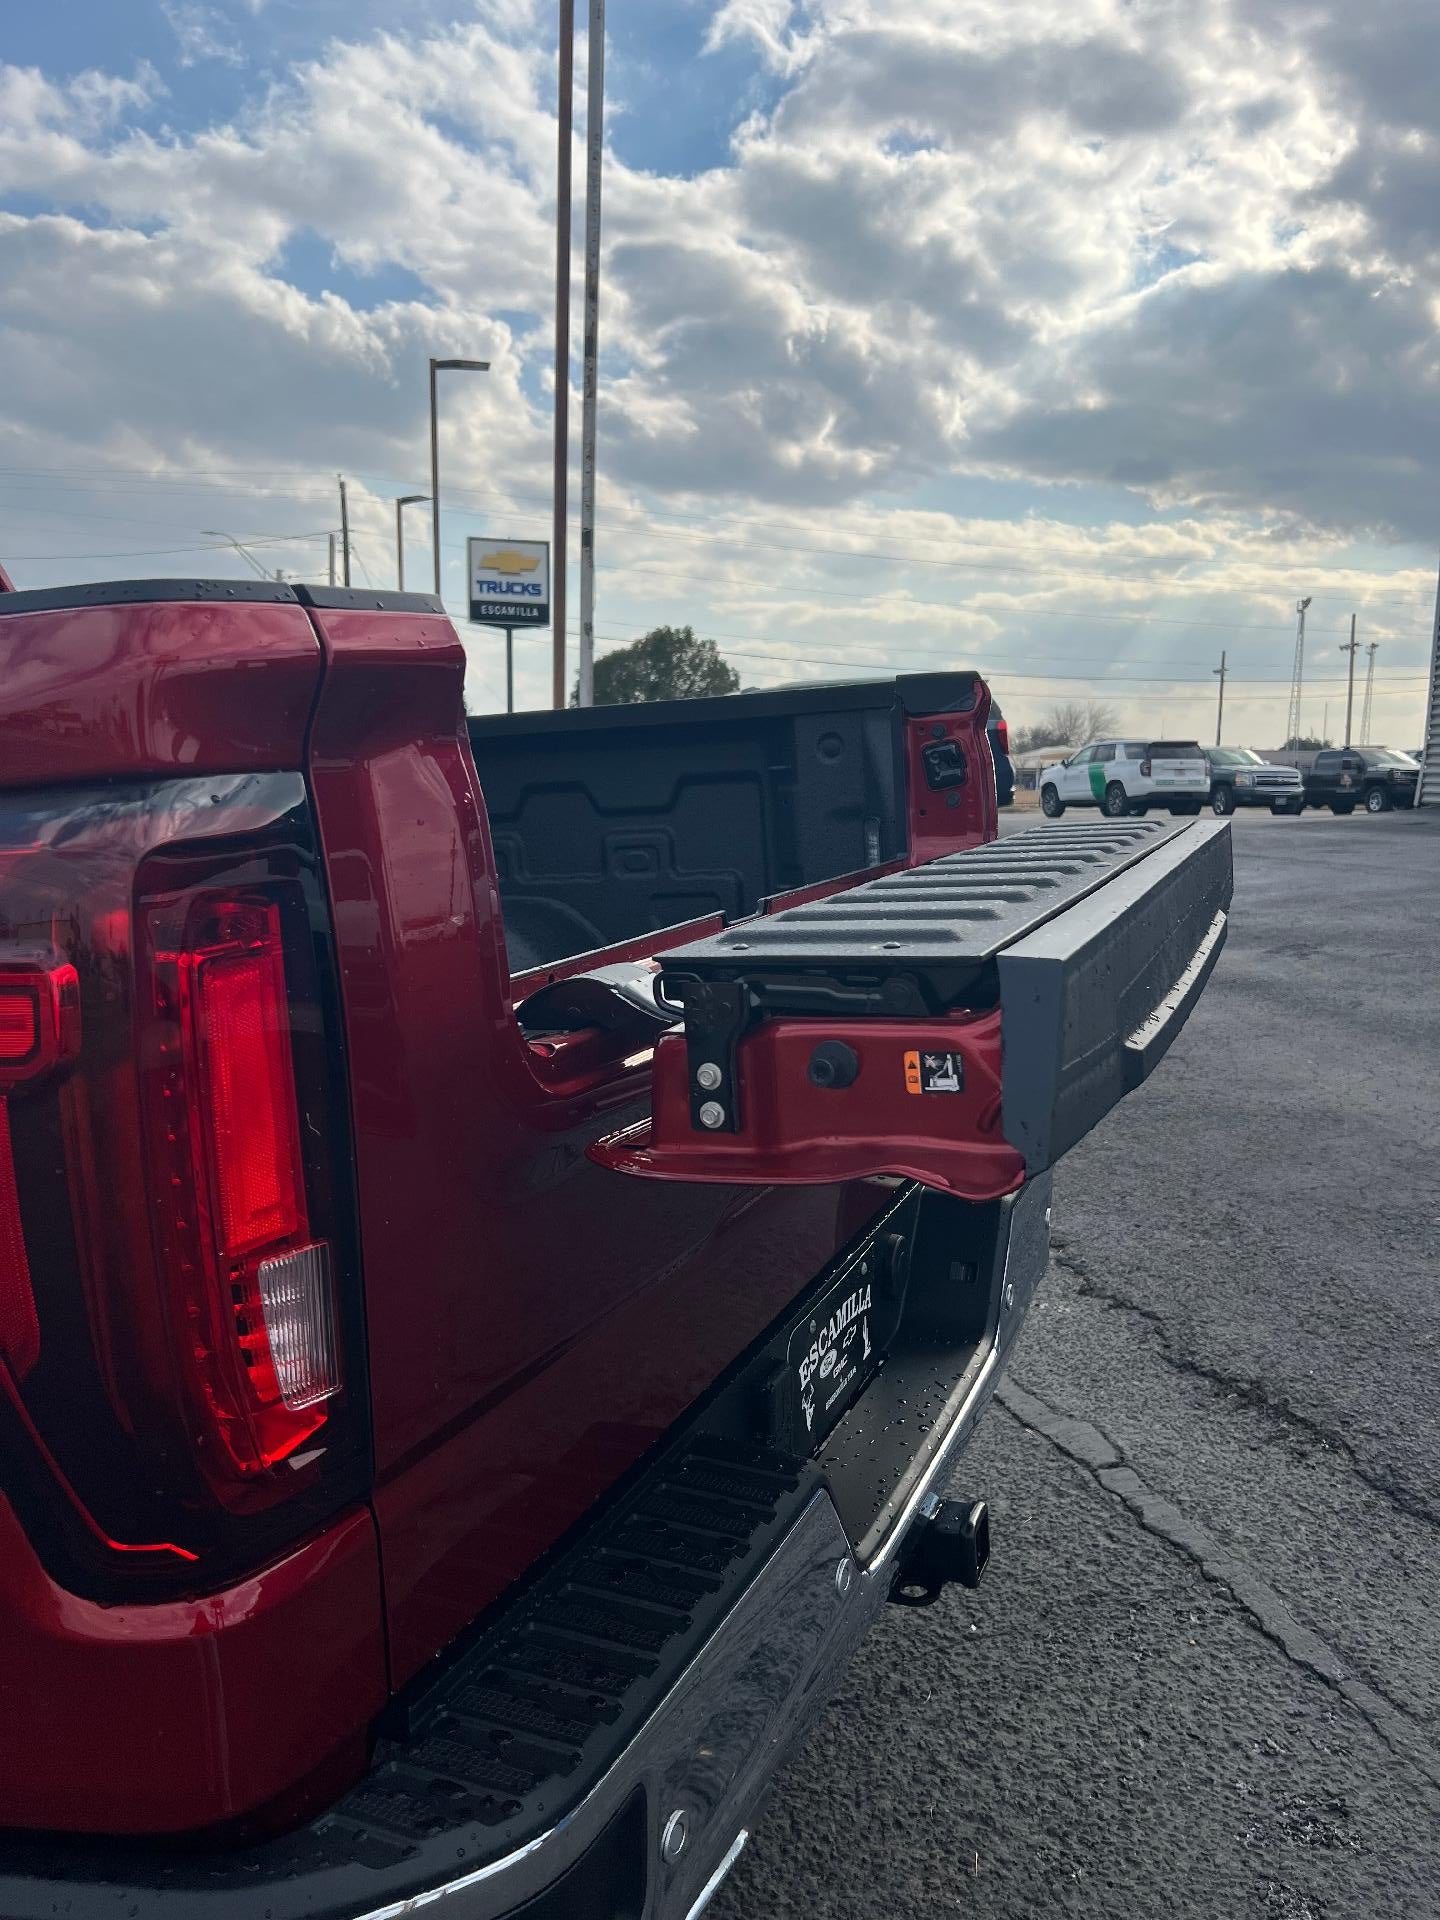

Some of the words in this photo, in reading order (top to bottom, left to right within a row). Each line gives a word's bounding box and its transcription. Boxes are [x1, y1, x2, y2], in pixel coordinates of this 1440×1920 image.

[477, 580, 541, 596] TRUCKS
[481, 605, 539, 617] ESCAMILLA
[799, 1284, 872, 1391] ESCAMILLA
